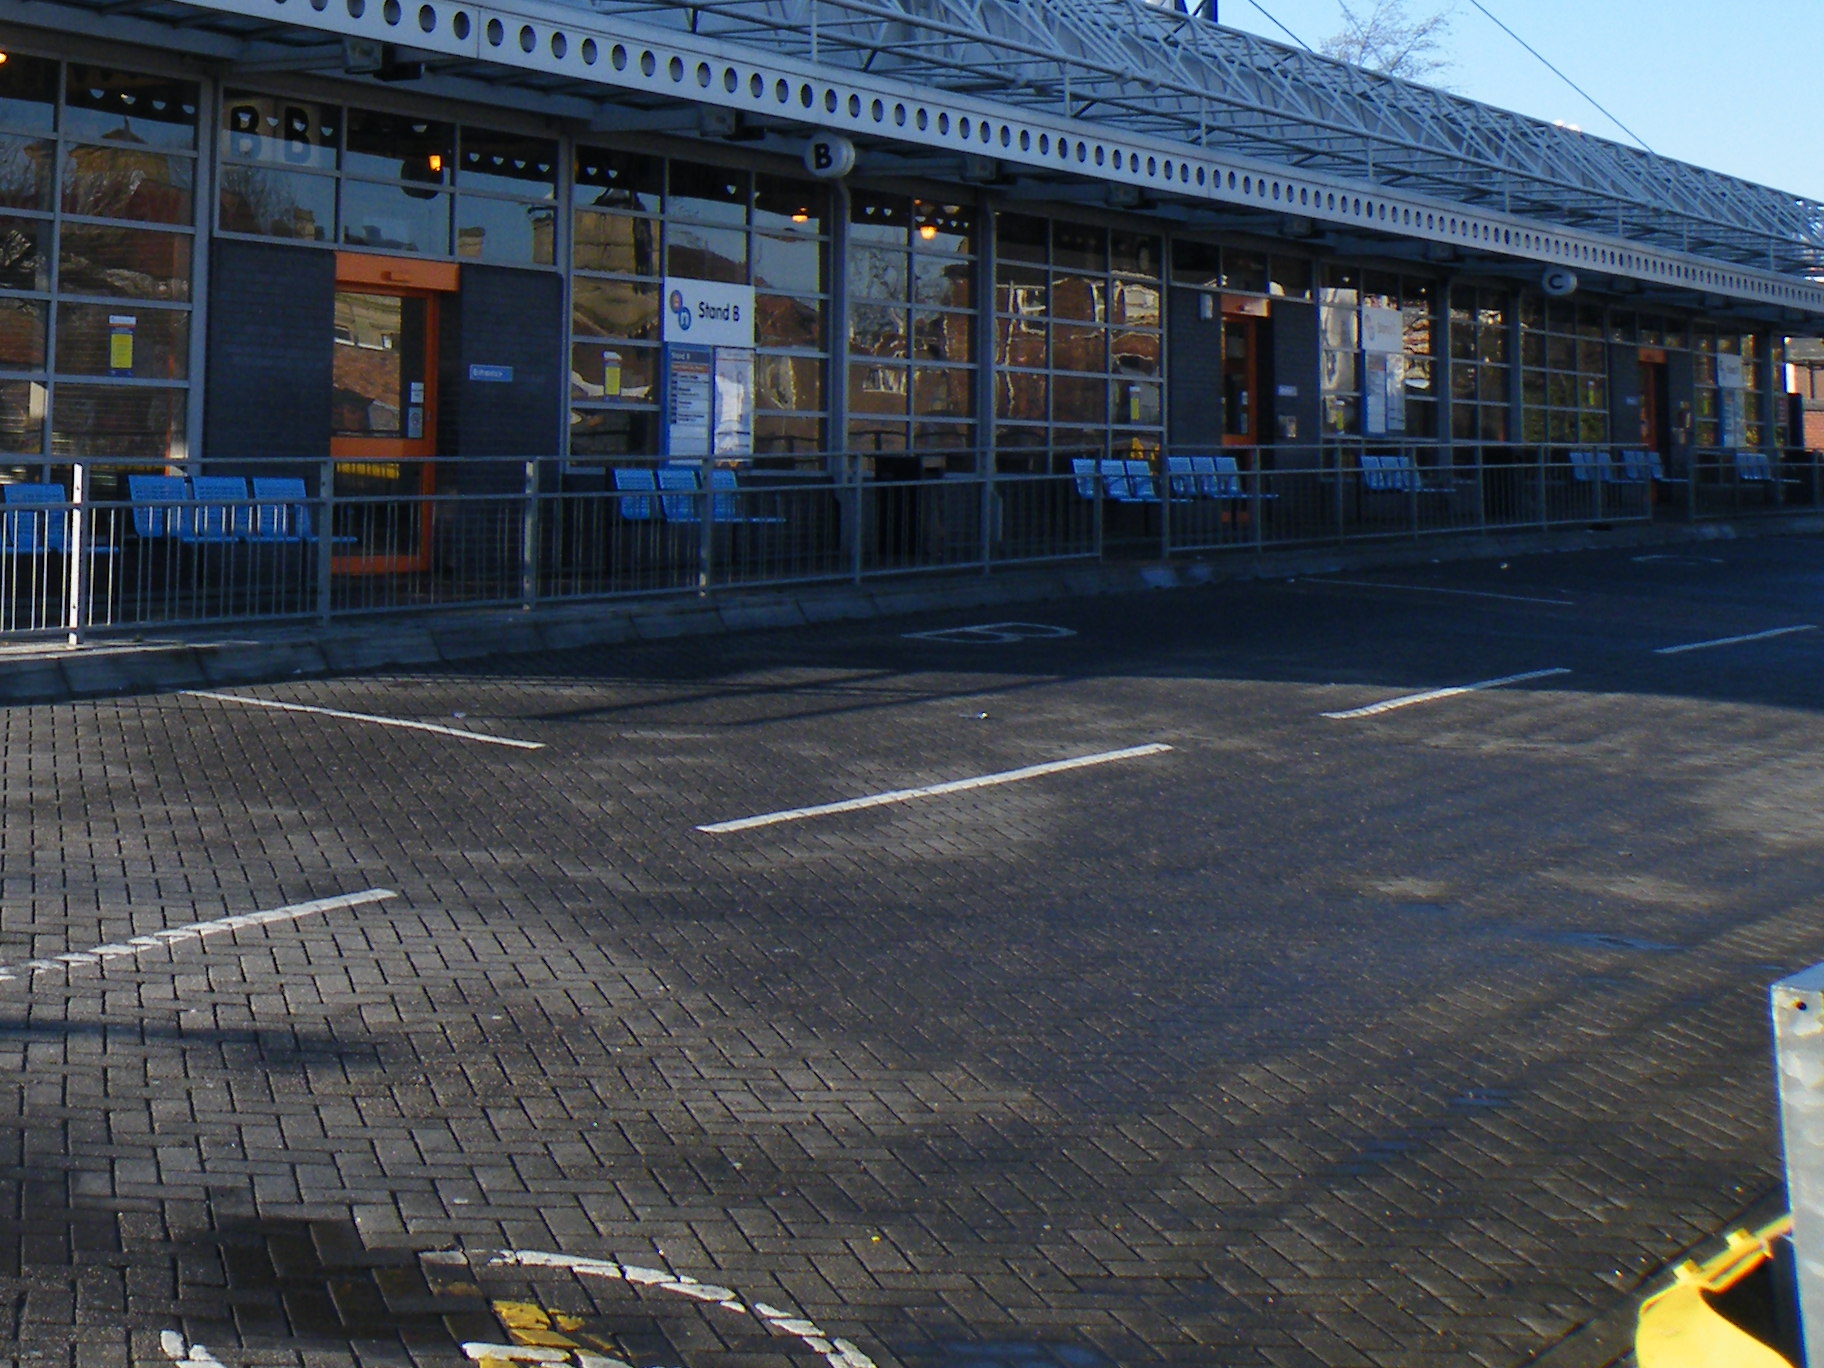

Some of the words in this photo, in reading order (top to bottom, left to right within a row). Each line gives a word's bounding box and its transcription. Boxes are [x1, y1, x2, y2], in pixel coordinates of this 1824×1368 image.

[230, 105, 260, 159] B
[284, 106, 311, 164] B
[814, 143, 832, 169] B
[1549, 273, 1563, 289] C
[699, 301, 730, 321] Stand
[733, 305, 740, 322] B
